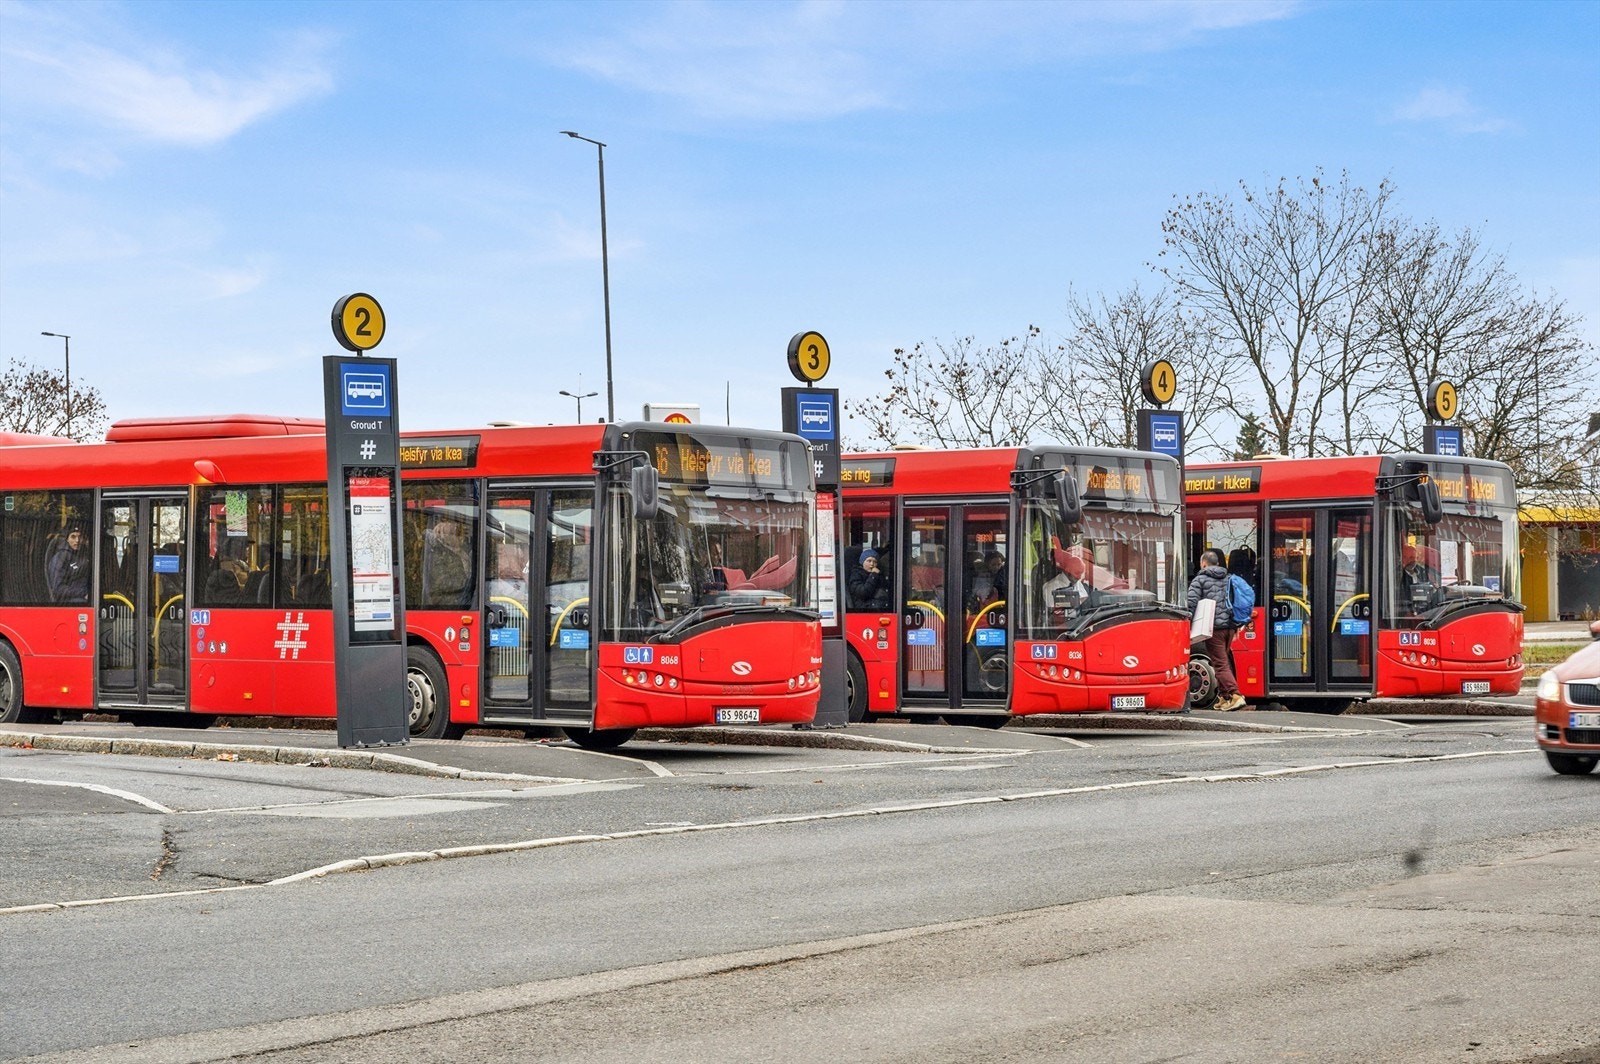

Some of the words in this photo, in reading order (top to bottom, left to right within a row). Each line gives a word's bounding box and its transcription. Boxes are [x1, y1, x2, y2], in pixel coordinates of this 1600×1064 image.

[354, 307, 372, 336] 2
[807, 343, 820, 371] 3
[1158, 370, 1168, 392] 4
[1442, 391, 1450, 411] 5
[350, 420, 376, 430] Grorud
[377, 420, 383, 430] T
[399, 446, 428, 464] Helsfyr
[430, 446, 443, 461] via
[445, 446, 462, 461] Ikea
[811, 443, 824, 452] orud
[824, 443, 829, 451] T
[681, 447, 722, 477] Helsfyr
[727, 452, 744, 475] via
[748, 452, 771, 476] Ikea
[854, 467, 871, 483] ring
[1123, 470, 1142, 495] ring
[1223, 474, 1251, 490] Huken
[1471, 477, 1496, 500] Huken
[660, 655, 679, 665] 8068
[1116, 697, 1124, 707] BS
[721, 710, 732, 720] BS
[734, 710, 758, 720] 98642
